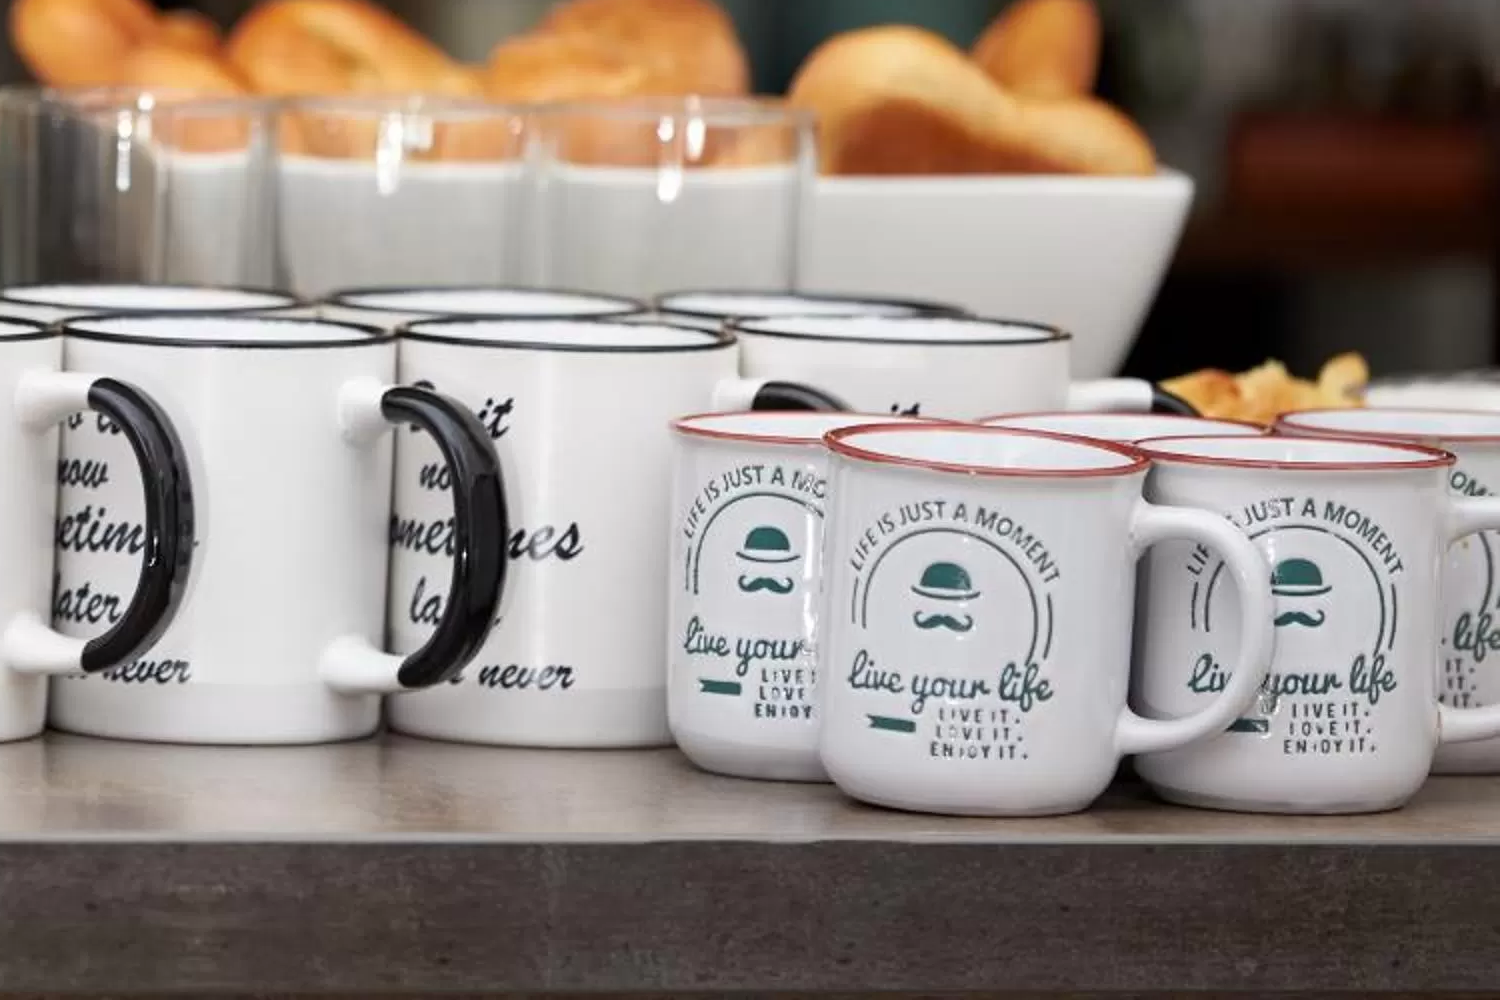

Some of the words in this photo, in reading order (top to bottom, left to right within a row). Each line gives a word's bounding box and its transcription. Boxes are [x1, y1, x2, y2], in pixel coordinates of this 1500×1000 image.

[684, 495, 707, 539] LIFE
[704, 480, 721, 503] IS
[722, 465, 765, 492] JUST
[771, 465, 785, 486] A
[851, 528, 879, 572] LIFE
[878, 512, 896, 535] IS
[899, 501, 947, 526] JUST
[952, 503, 968, 523] A
[975, 506, 1061, 583] MOMENT
[1243, 498, 1294, 526] JUST
[1301, 498, 1317, 518] A
[1323, 501, 1404, 575] MOMENT
[479, 664, 574, 690] never
[684, 615, 730, 656] live
[736, 637, 814, 678] your
[761, 668, 804, 684] LIVE
[848, 650, 904, 693] live
[911, 674, 991, 714] your
[998, 661, 1054, 712] life
[1187, 653, 1232, 693] liv
[1350, 653, 1397, 705] life
